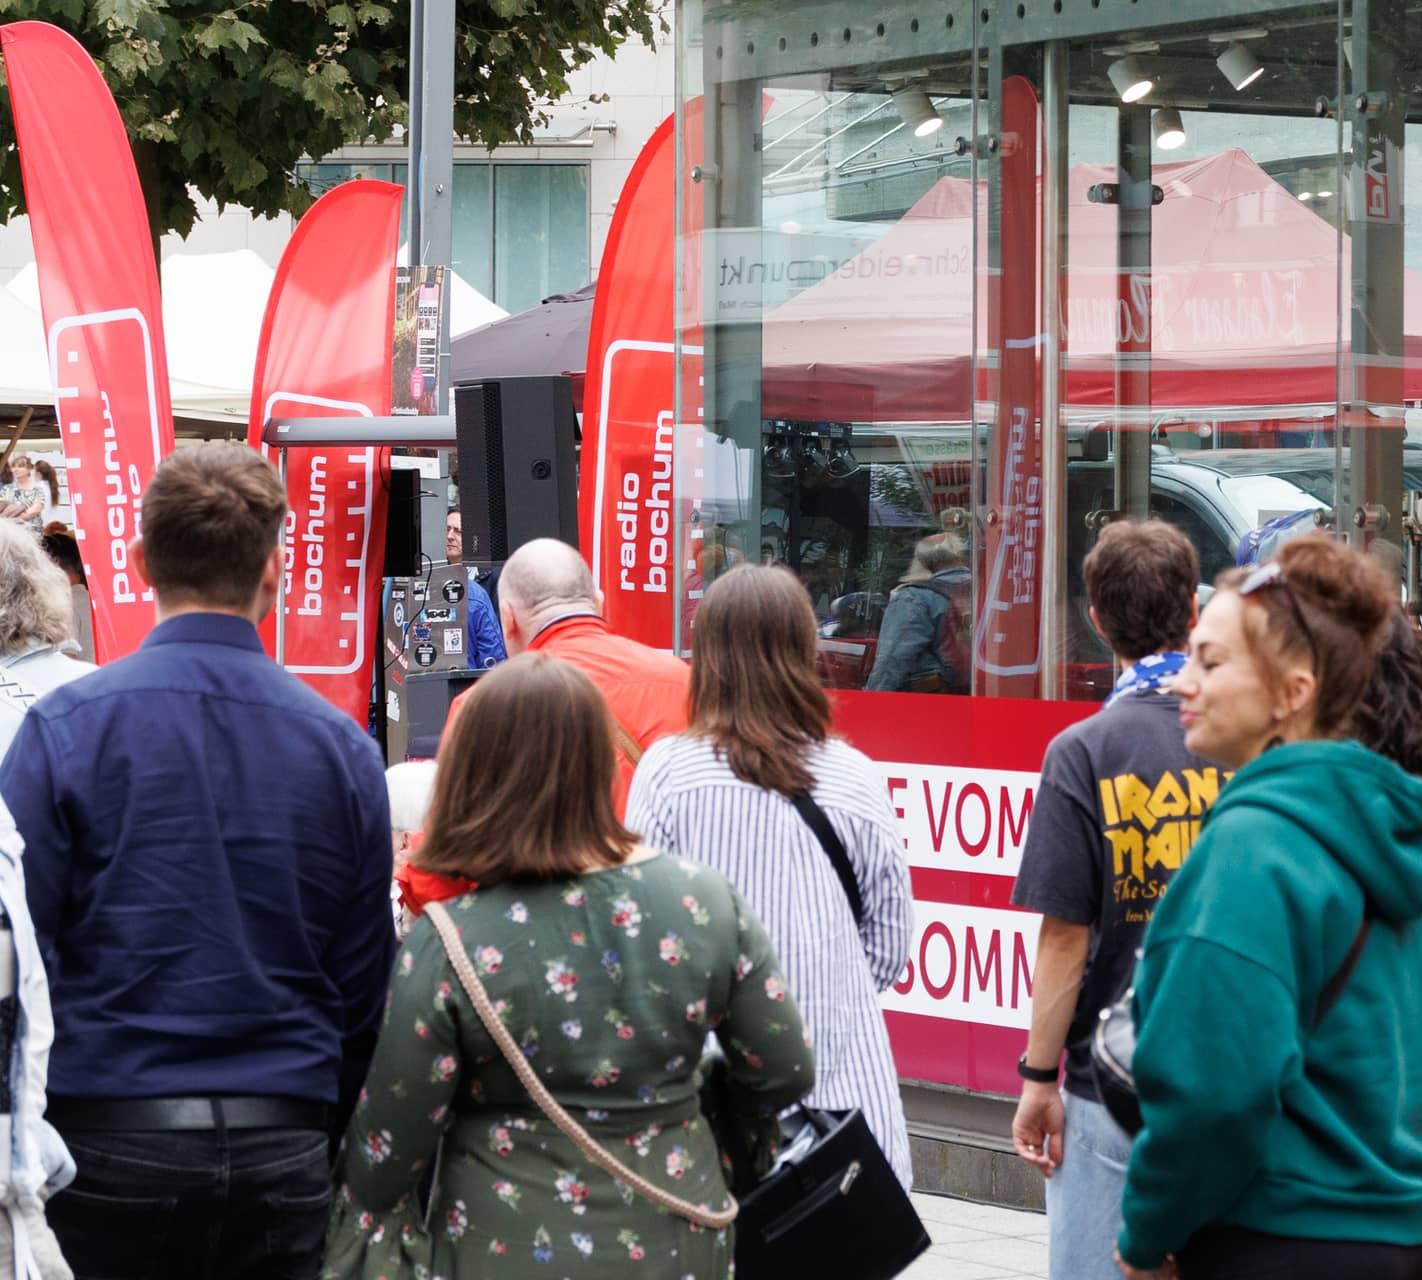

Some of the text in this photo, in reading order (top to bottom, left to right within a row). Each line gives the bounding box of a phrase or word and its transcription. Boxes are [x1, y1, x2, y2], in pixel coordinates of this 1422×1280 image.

[297, 455, 328, 616] bochum
[616, 472, 640, 591] radio
[643, 410, 674, 593] bochum
[1099, 767, 1219, 831] IRON
[1104, 820, 1202, 884] MAI
